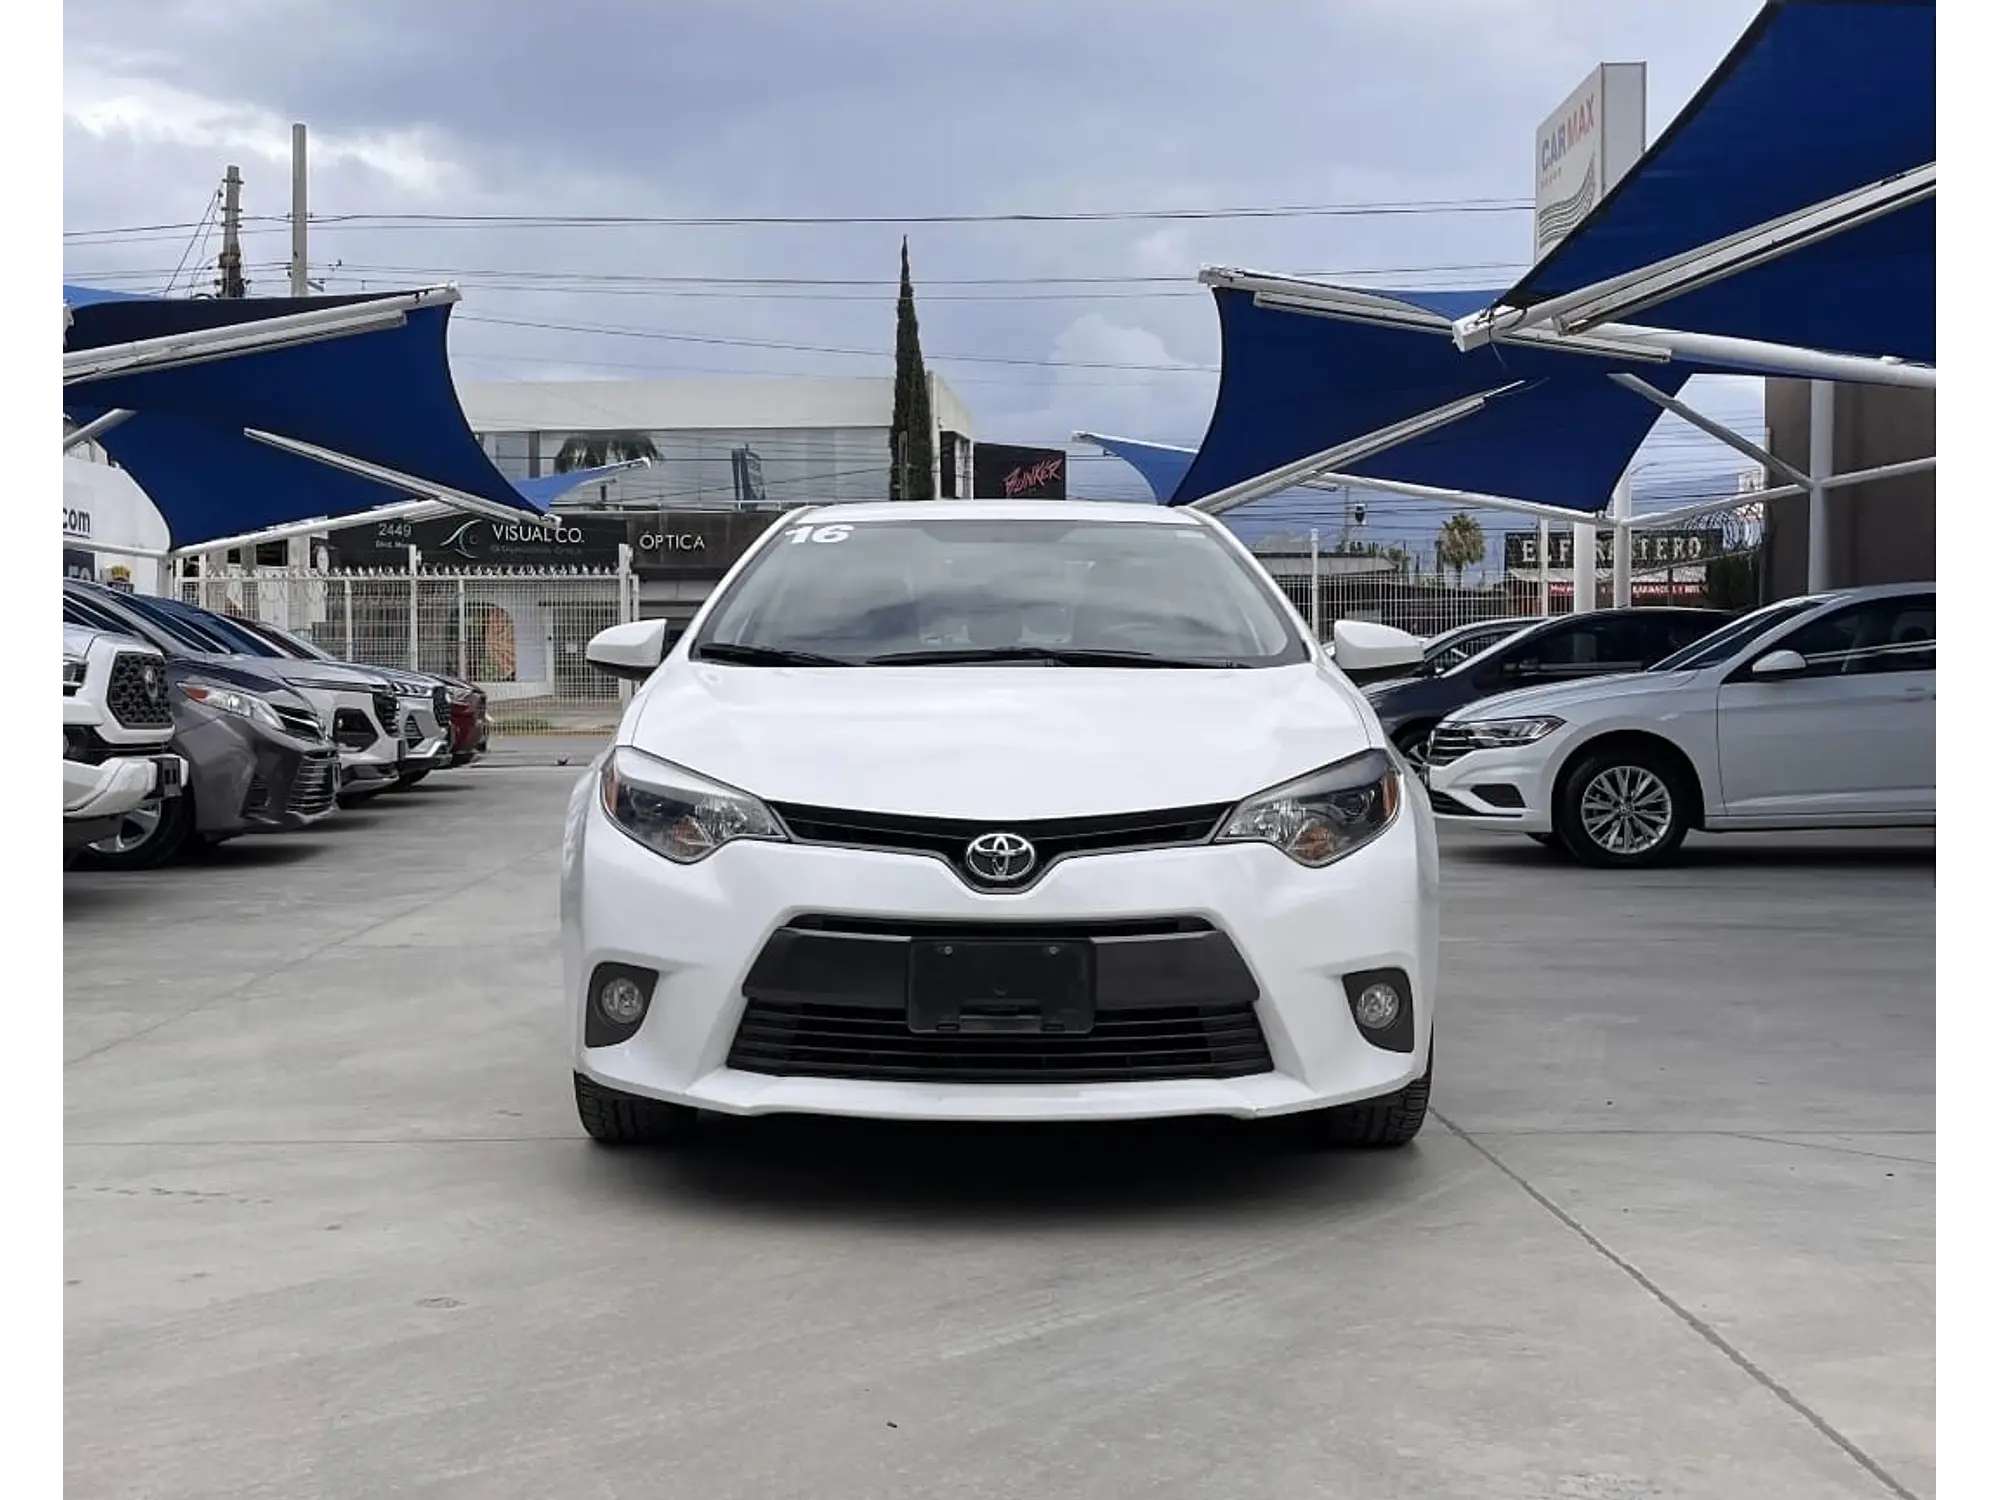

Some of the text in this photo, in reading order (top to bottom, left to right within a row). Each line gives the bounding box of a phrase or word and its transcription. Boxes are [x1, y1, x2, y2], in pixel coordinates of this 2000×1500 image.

[1542, 92, 1594, 170] CARMAX
[378, 523, 412, 537] 2449
[492, 523, 552, 542] VISUAL
[785, 524, 855, 544] 16
[1522, 539, 1552, 562] E
